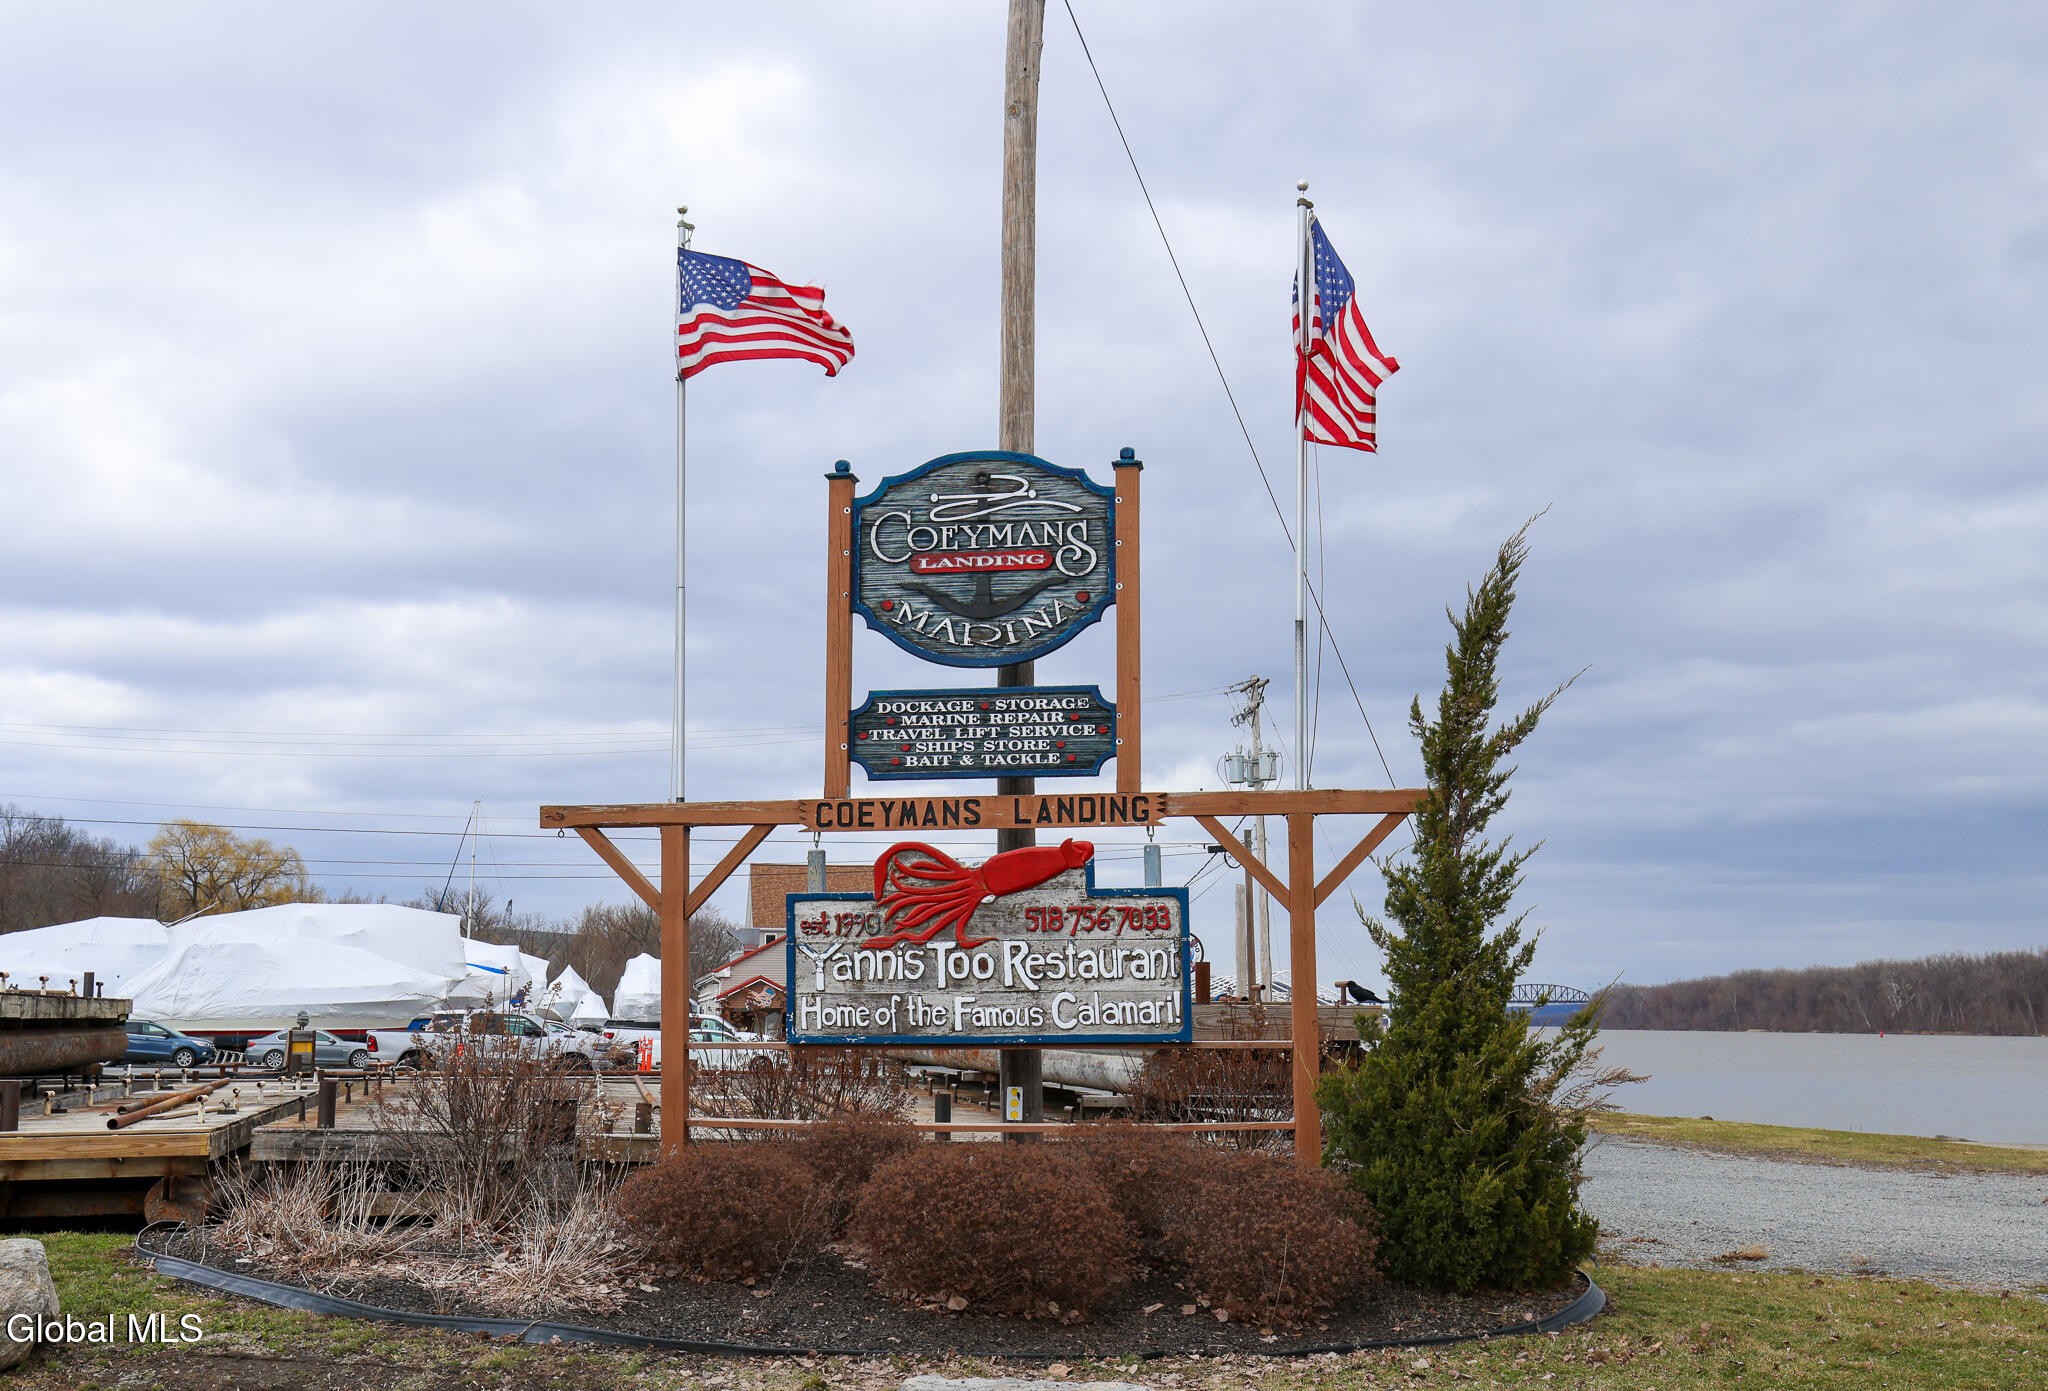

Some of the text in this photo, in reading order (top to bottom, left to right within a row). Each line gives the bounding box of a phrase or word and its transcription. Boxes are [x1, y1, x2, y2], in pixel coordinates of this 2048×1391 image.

[871, 509, 1097, 577] COEYMANS
[918, 553, 1046, 570] LANDING
[891, 598, 1087, 648] MARINA
[876, 697, 1090, 714] DOCKAGE STORAGE
[900, 711, 1065, 726] MARINE REPAIR
[868, 724, 1096, 741] TRAVEL LIFT SERVICE
[915, 739, 1050, 753] SHIPS STORE
[904, 752, 1061, 767] BAIT & TACKLE
[815, 796, 1150, 828] COEYMANS LANDING
[800, 911, 880, 937] est 1990
[1024, 905, 1171, 936] 518-756-7033
[926, 941, 995, 989] Too
[1003, 939, 1179, 991] Restaurant
[801, 991, 1181, 1033] Home of the Famous Calamari!
